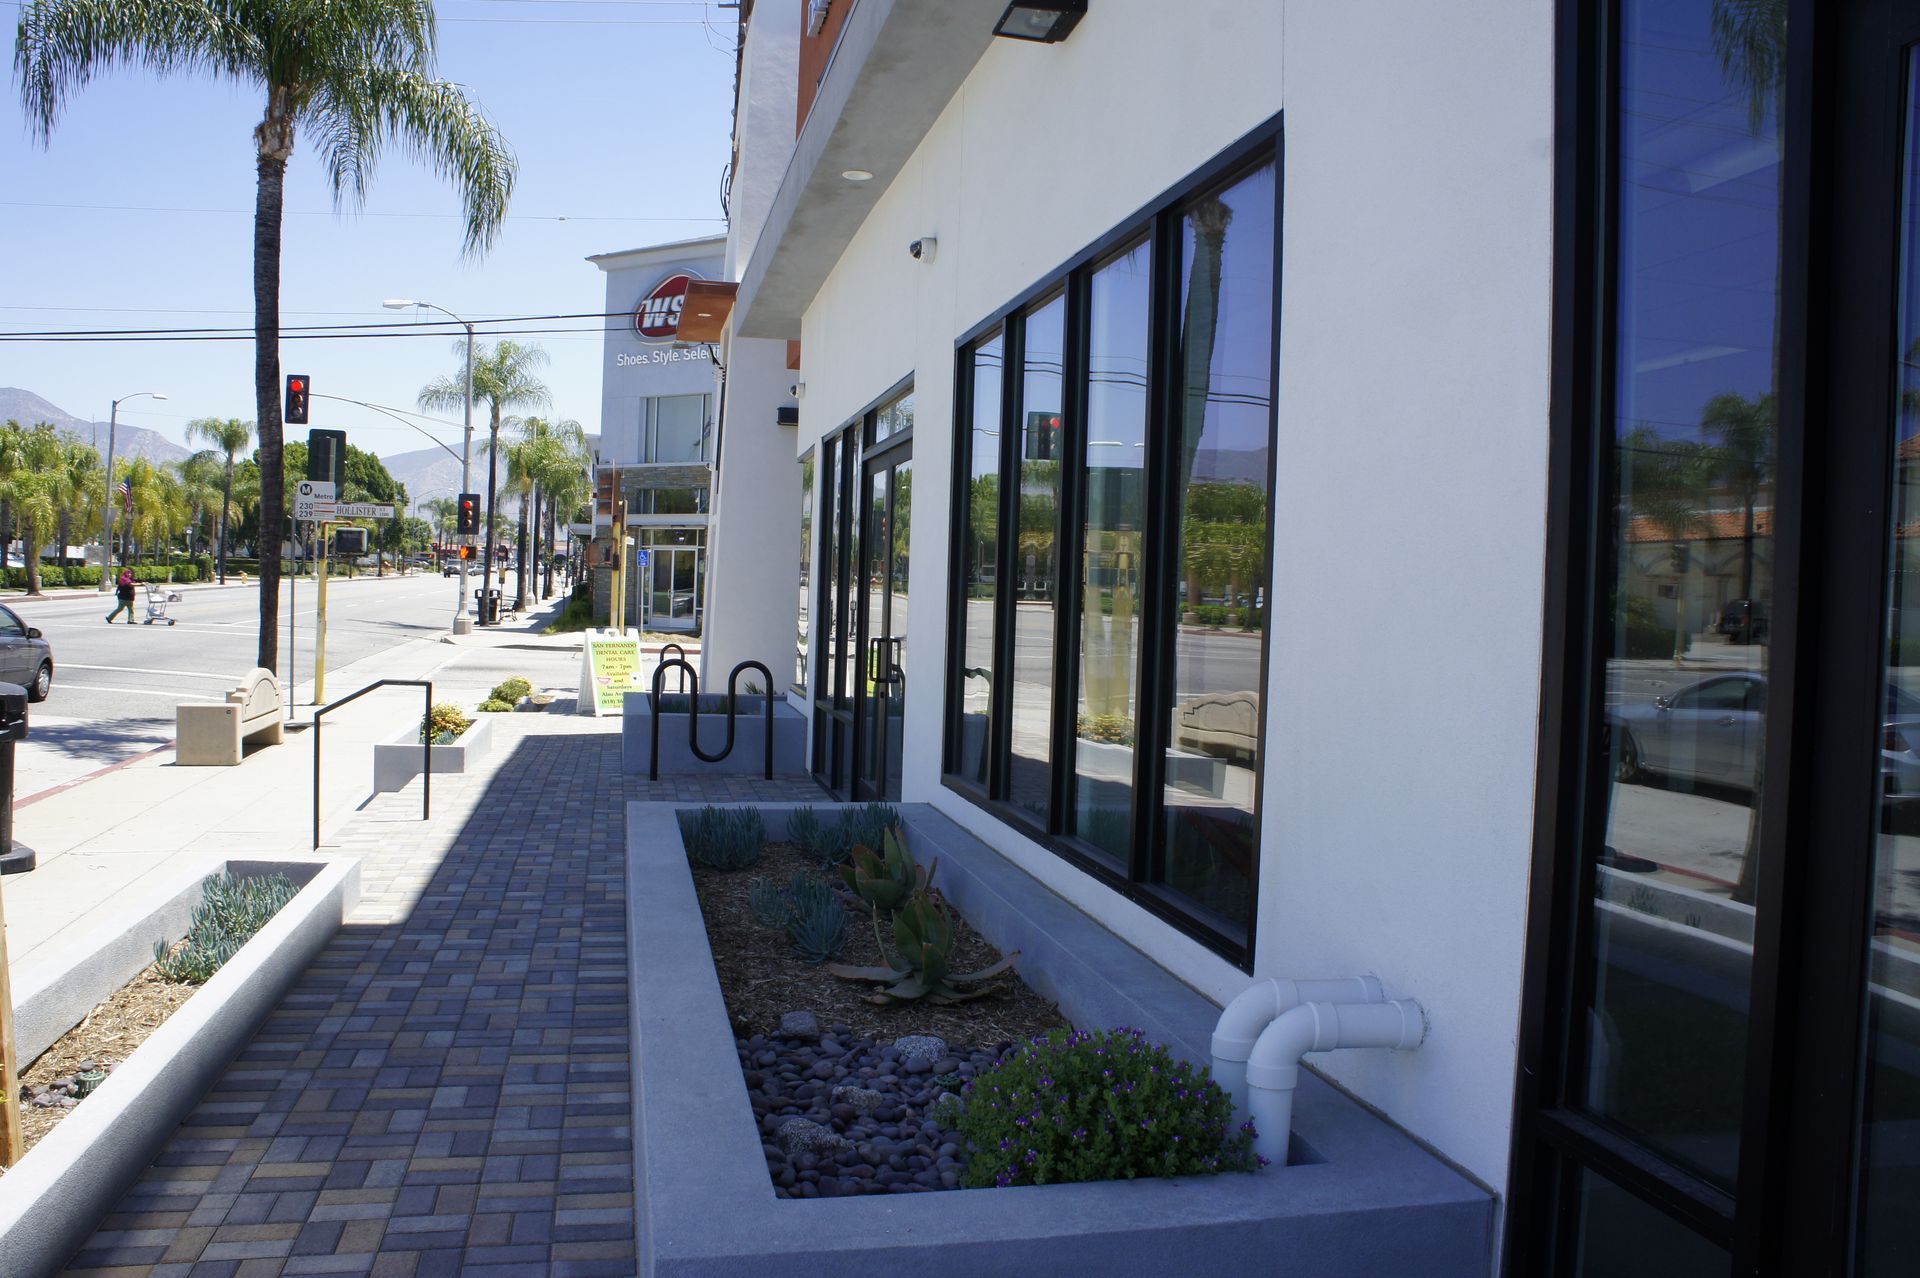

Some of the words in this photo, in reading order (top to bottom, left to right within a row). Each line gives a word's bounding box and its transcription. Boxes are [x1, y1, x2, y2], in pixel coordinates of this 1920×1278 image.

[617, 354, 650, 366] Shoes.
[653, 350, 680, 365] Style.
[336, 505, 377, 516] HOLLISTER
